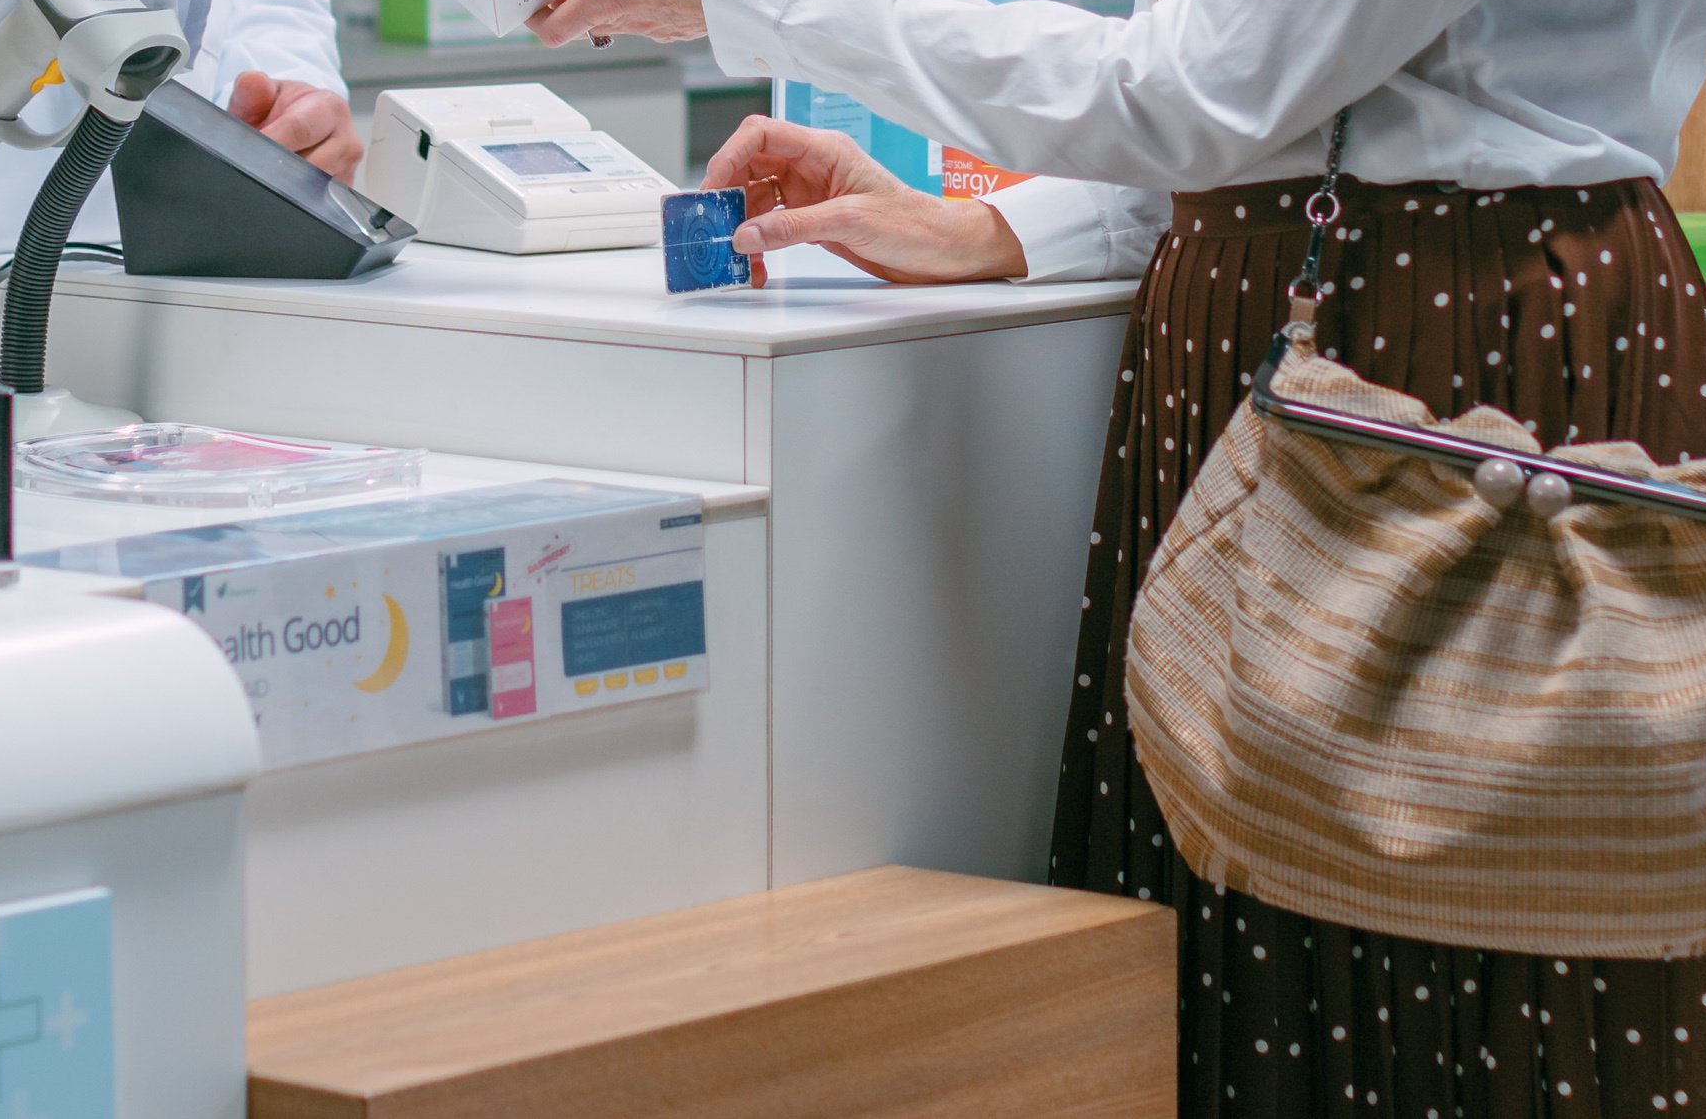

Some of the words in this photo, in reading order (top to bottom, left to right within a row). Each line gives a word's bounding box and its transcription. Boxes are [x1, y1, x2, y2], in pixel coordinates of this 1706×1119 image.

[954, 160, 973, 170] SOME
[568, 564, 637, 595] TREATS
[217, 621, 275, 663] alth
[283, 605, 360, 654] Good
